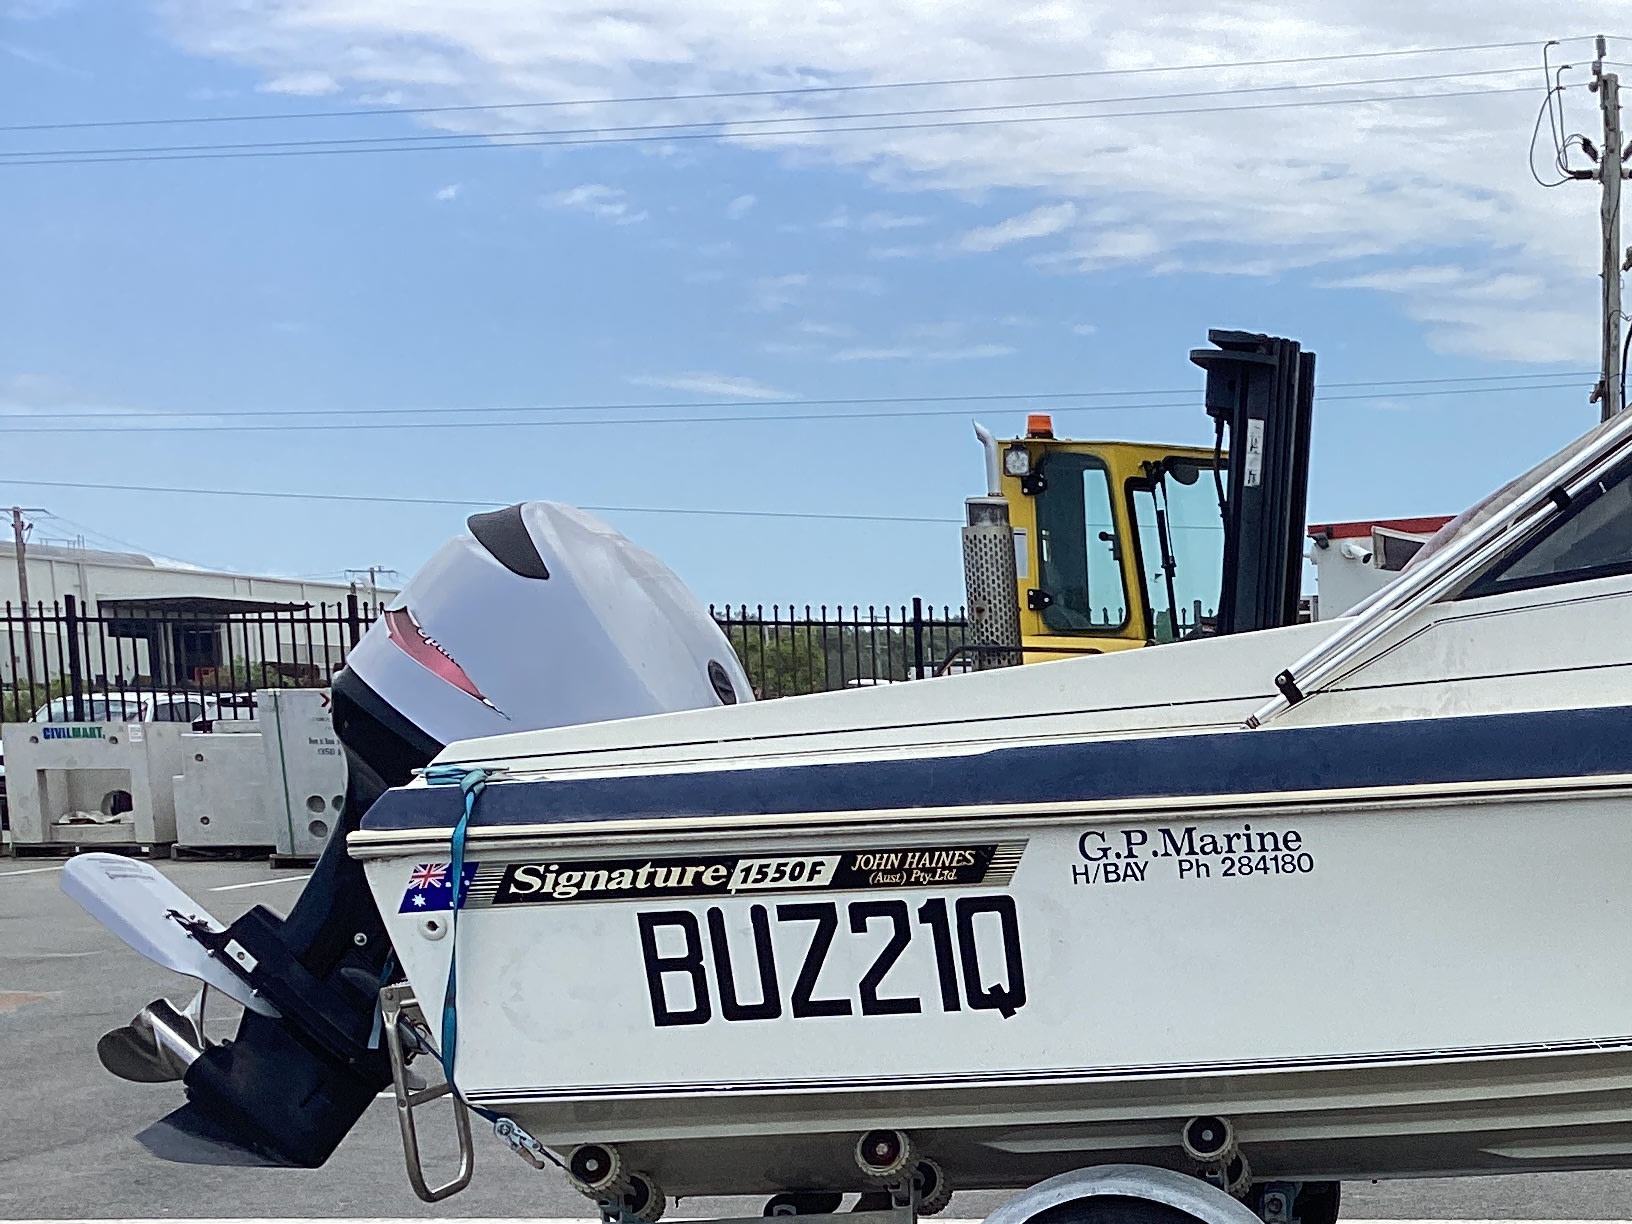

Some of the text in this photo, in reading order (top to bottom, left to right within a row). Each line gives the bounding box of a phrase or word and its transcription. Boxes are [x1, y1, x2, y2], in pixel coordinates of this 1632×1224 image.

[851, 850, 976, 871] JOHN HAINES
[1072, 852, 1315, 885] H/BAY Ph 284180
[508, 858, 827, 898] Signature 1550F
[868, 870, 907, 885] (Aust)
[637, 894, 1027, 1028] BUZ21Q
